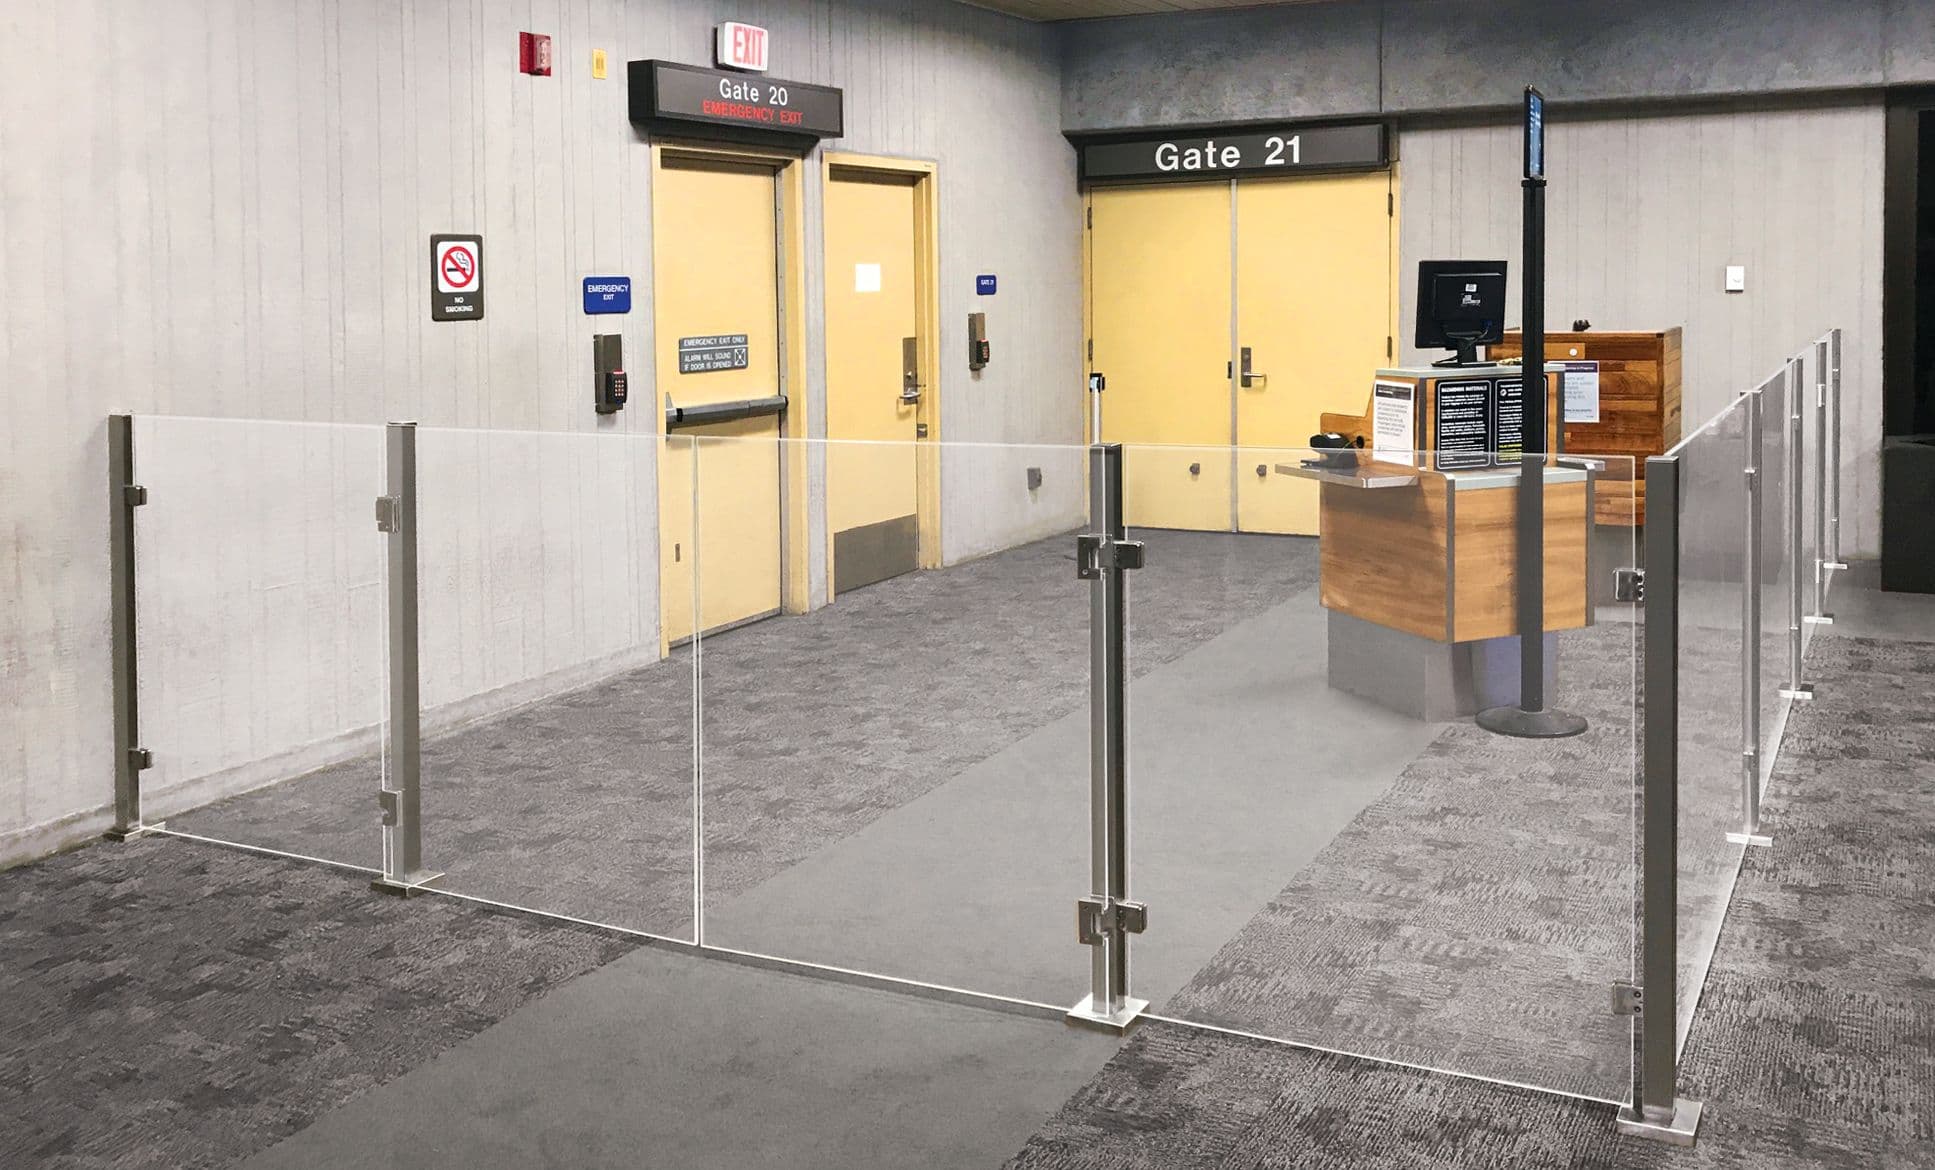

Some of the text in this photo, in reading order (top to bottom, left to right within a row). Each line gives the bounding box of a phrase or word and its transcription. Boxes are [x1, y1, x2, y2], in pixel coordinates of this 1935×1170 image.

[733, 25, 763, 66] EXIT
[720, 78, 788, 105] Gate 20
[703, 99, 803, 125] EMERGENCY EXIT
[1155, 135, 1300, 171] Gate 21
[587, 284, 629, 293] EMERGENCY
[454, 296, 464, 304] NO
[603, 293, 615, 301] EXIT
[445, 305, 474, 313] SMOKING
[683, 336, 745, 347] EMERGENCY EXIT ONLY
[684, 352, 732, 362] ALARM WILL SOUND
[690, 363, 705, 371] DOOR
[712, 361, 732, 369] OPENED
